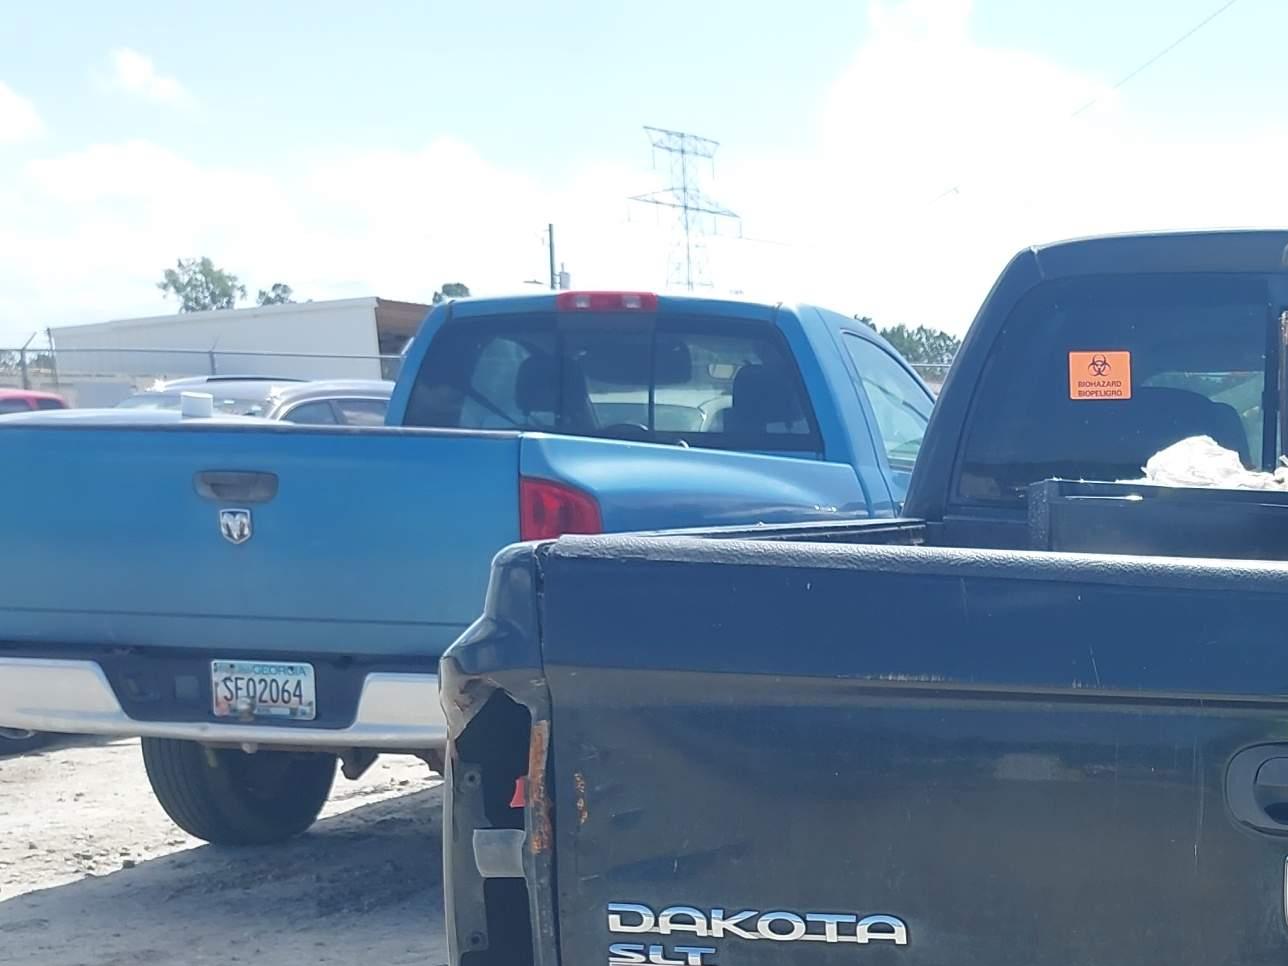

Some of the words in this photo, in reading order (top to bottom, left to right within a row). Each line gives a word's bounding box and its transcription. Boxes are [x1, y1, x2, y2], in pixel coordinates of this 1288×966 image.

[1078, 380, 1122, 388] BIOHAZARD
[607, 902, 908, 945] DAKOTA
[608, 942, 717, 966] SLT
